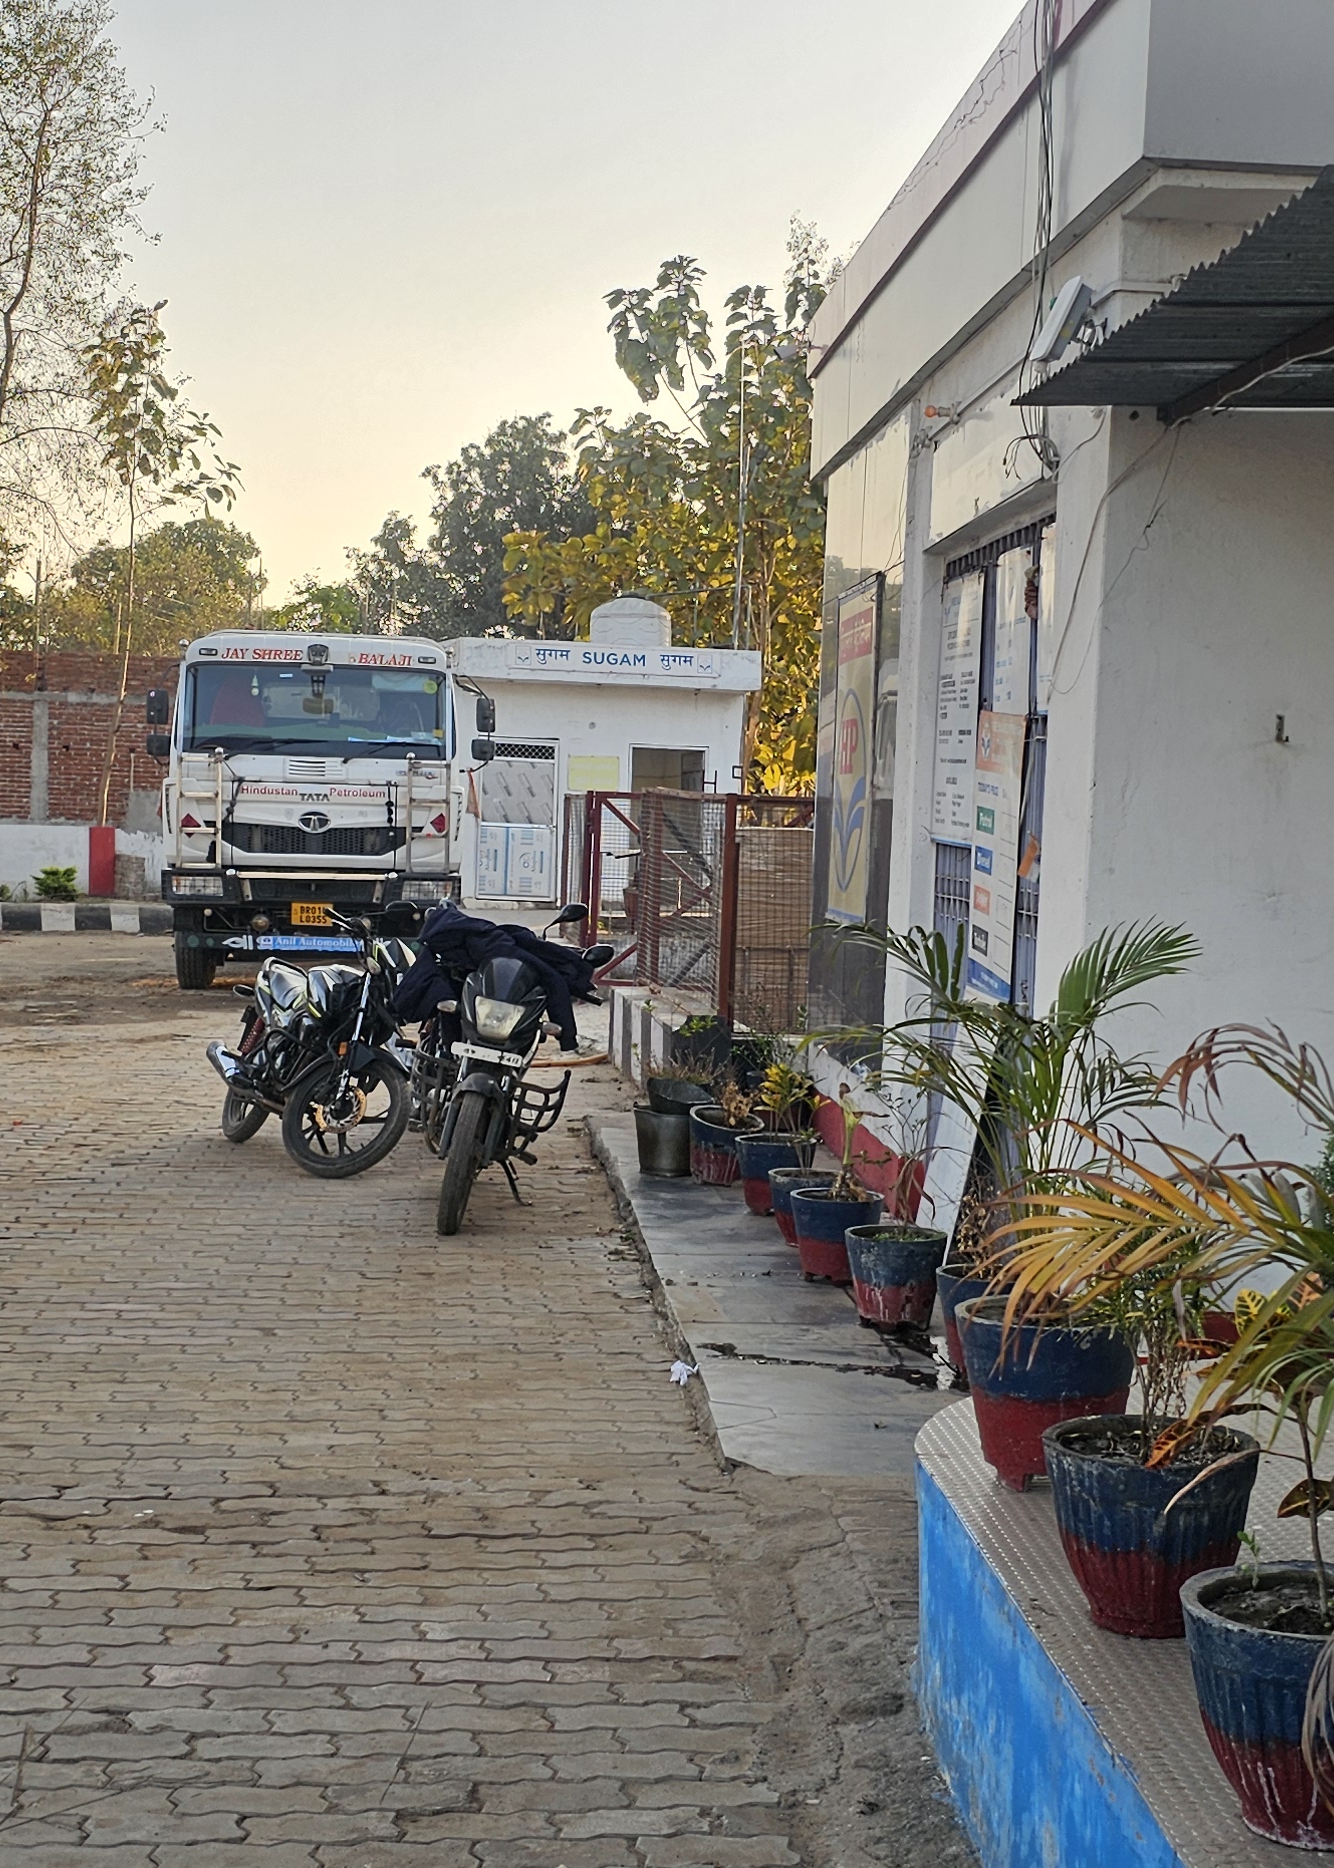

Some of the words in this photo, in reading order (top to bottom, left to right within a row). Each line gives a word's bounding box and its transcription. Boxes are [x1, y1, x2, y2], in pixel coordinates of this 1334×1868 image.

[221, 647, 250, 660] JAY
[252, 648, 304, 662] SHREE
[357, 652, 413, 666] BALAJI
[535, 648, 570, 665] सुगम
[582, 651, 646, 667] SUGAM
[660, 654, 694, 671] सुगम
[840, 717, 859, 775] HP
[241, 785, 298, 797] Hindustan
[329, 787, 386, 799] Petroleum
[299, 793, 331, 802] TATA
[274, 936, 296, 947] Anil
